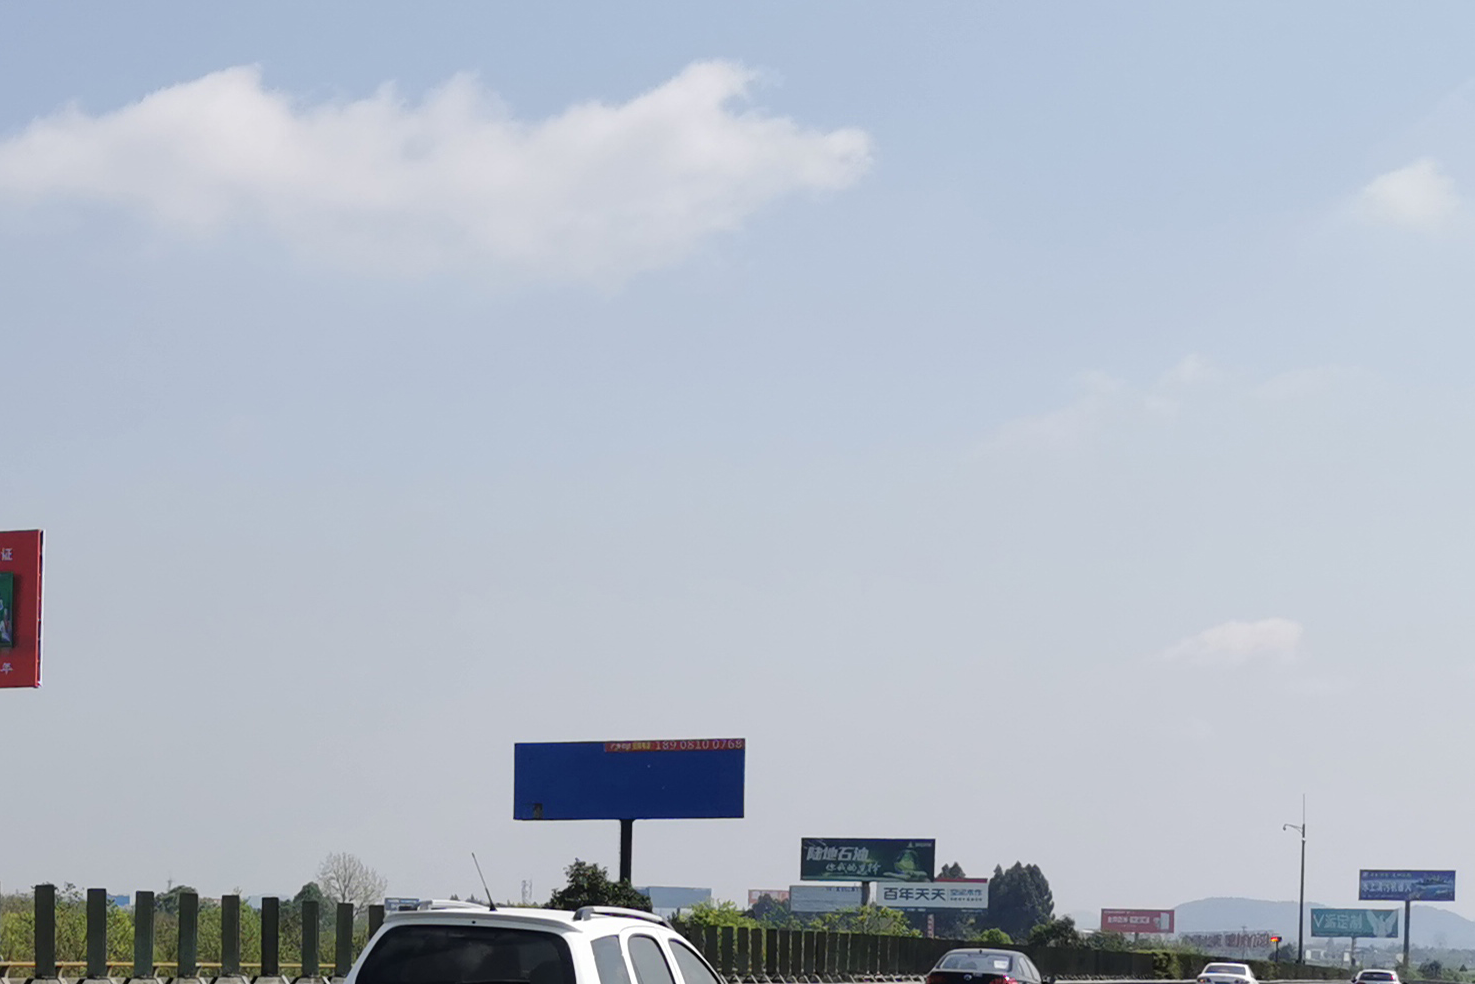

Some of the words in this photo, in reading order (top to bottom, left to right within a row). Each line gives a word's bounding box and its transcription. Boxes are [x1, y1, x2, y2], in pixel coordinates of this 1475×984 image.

[806, 846, 869, 861] 陆地石油
[883, 887, 946, 901] 百年天天
